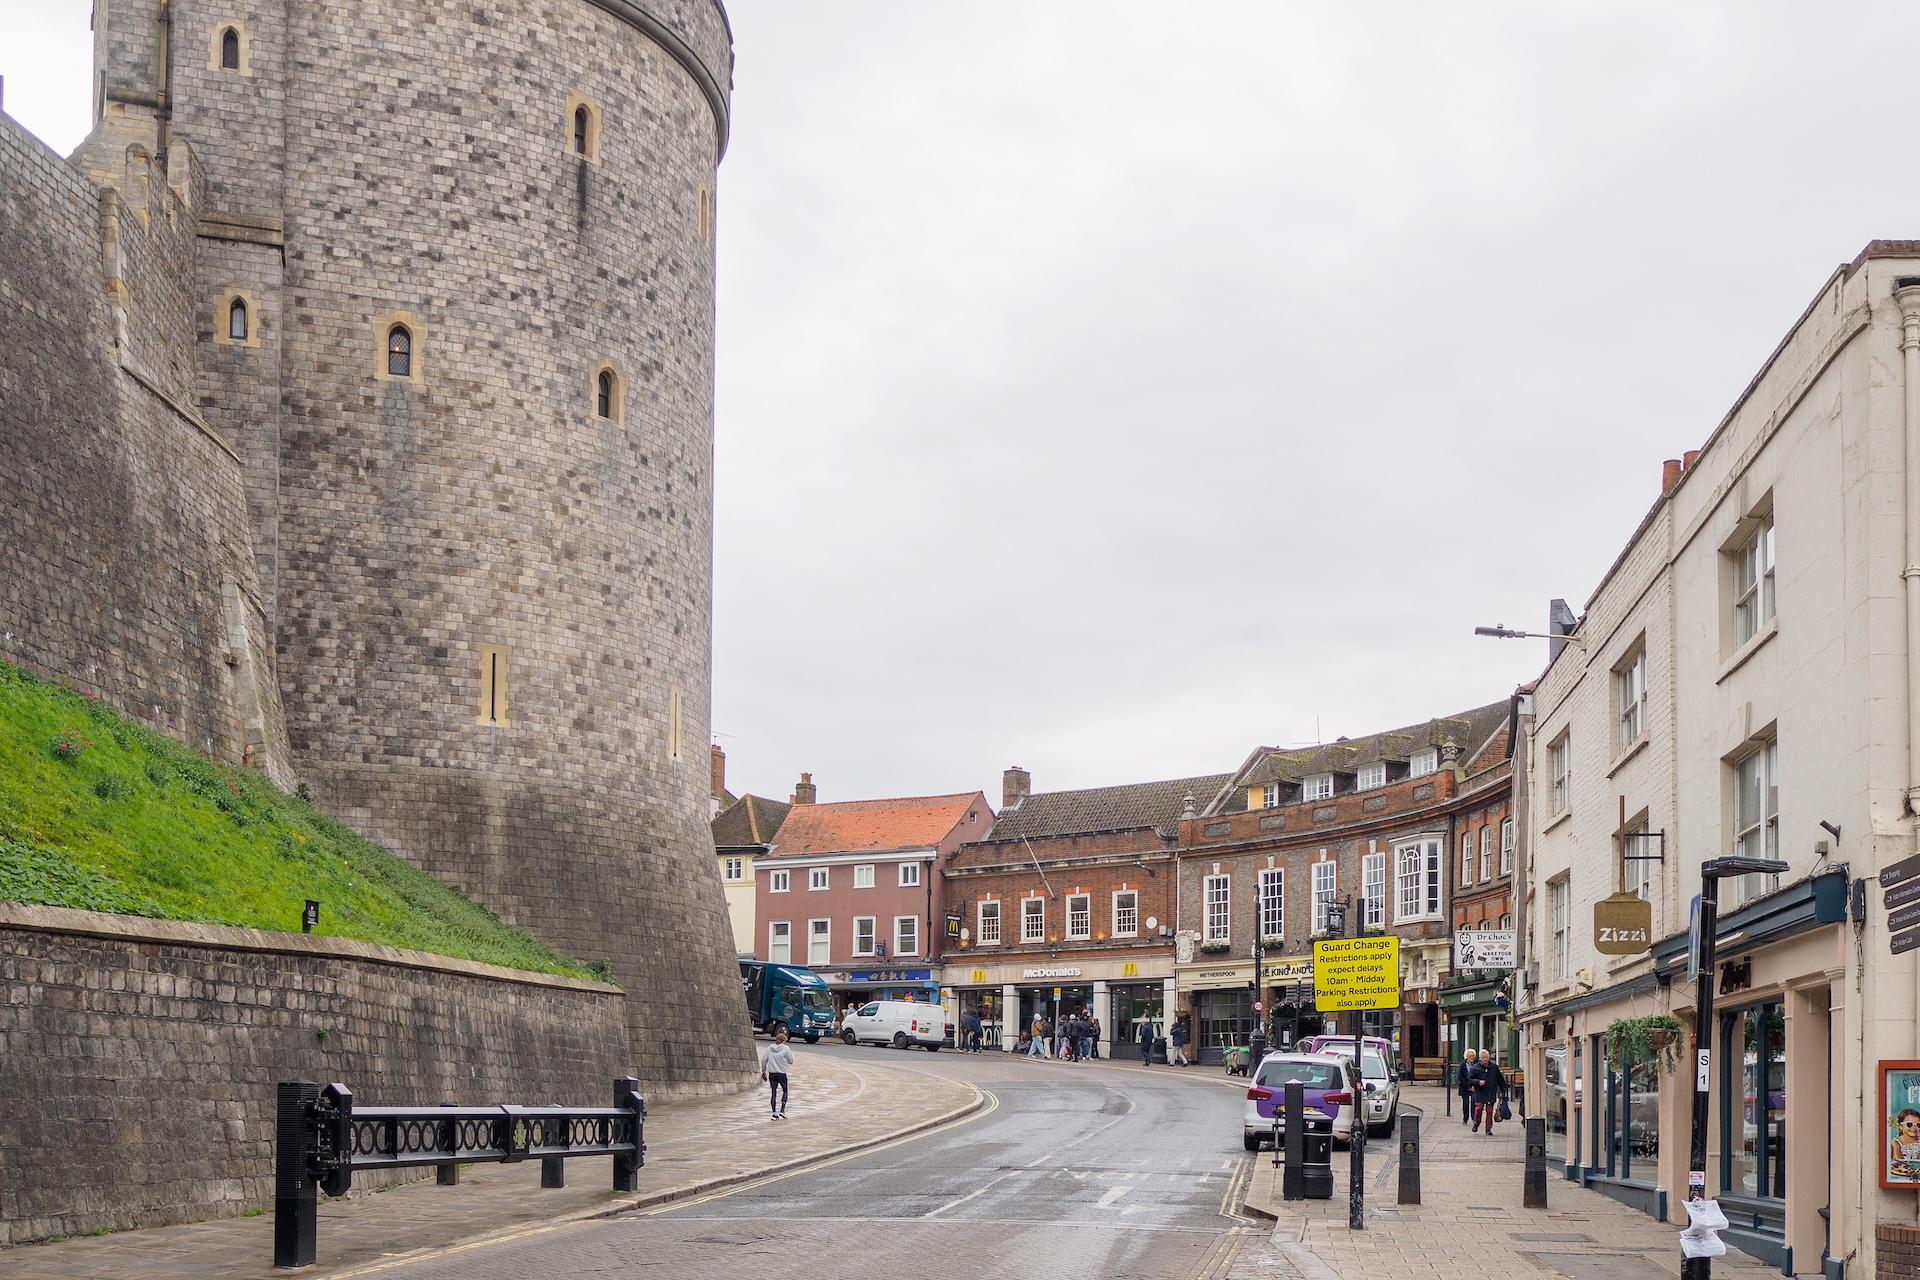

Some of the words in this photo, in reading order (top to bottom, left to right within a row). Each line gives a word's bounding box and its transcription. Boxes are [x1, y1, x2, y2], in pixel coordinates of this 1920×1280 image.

[1598, 927, 1647, 942] Zizzi
[1321, 942, 1351, 952] Guard
[1354, 941, 1390, 949] Change
[1320, 954, 1368, 963] Restrictions
[1370, 952, 1392, 961] apply
[1023, 967, 1081, 978] McDonald's
[1271, 967, 1290, 977] KING
[1291, 966, 1307, 975] AND
[1328, 965, 1355, 974] expect
[1357, 964, 1384, 973] delays
[1326, 977, 1348, 985] 10am
[1356, 975, 1386, 983] Midday
[1316, 988, 1346, 997] Parking
[1348, 986, 1397, 995] Restrictions
[1336, 999, 1353, 1007] also
[1354, 998, 1377, 1007] apply
[1700, 1055, 1709, 1066] S
[1700, 1074, 1706, 1085] 1
